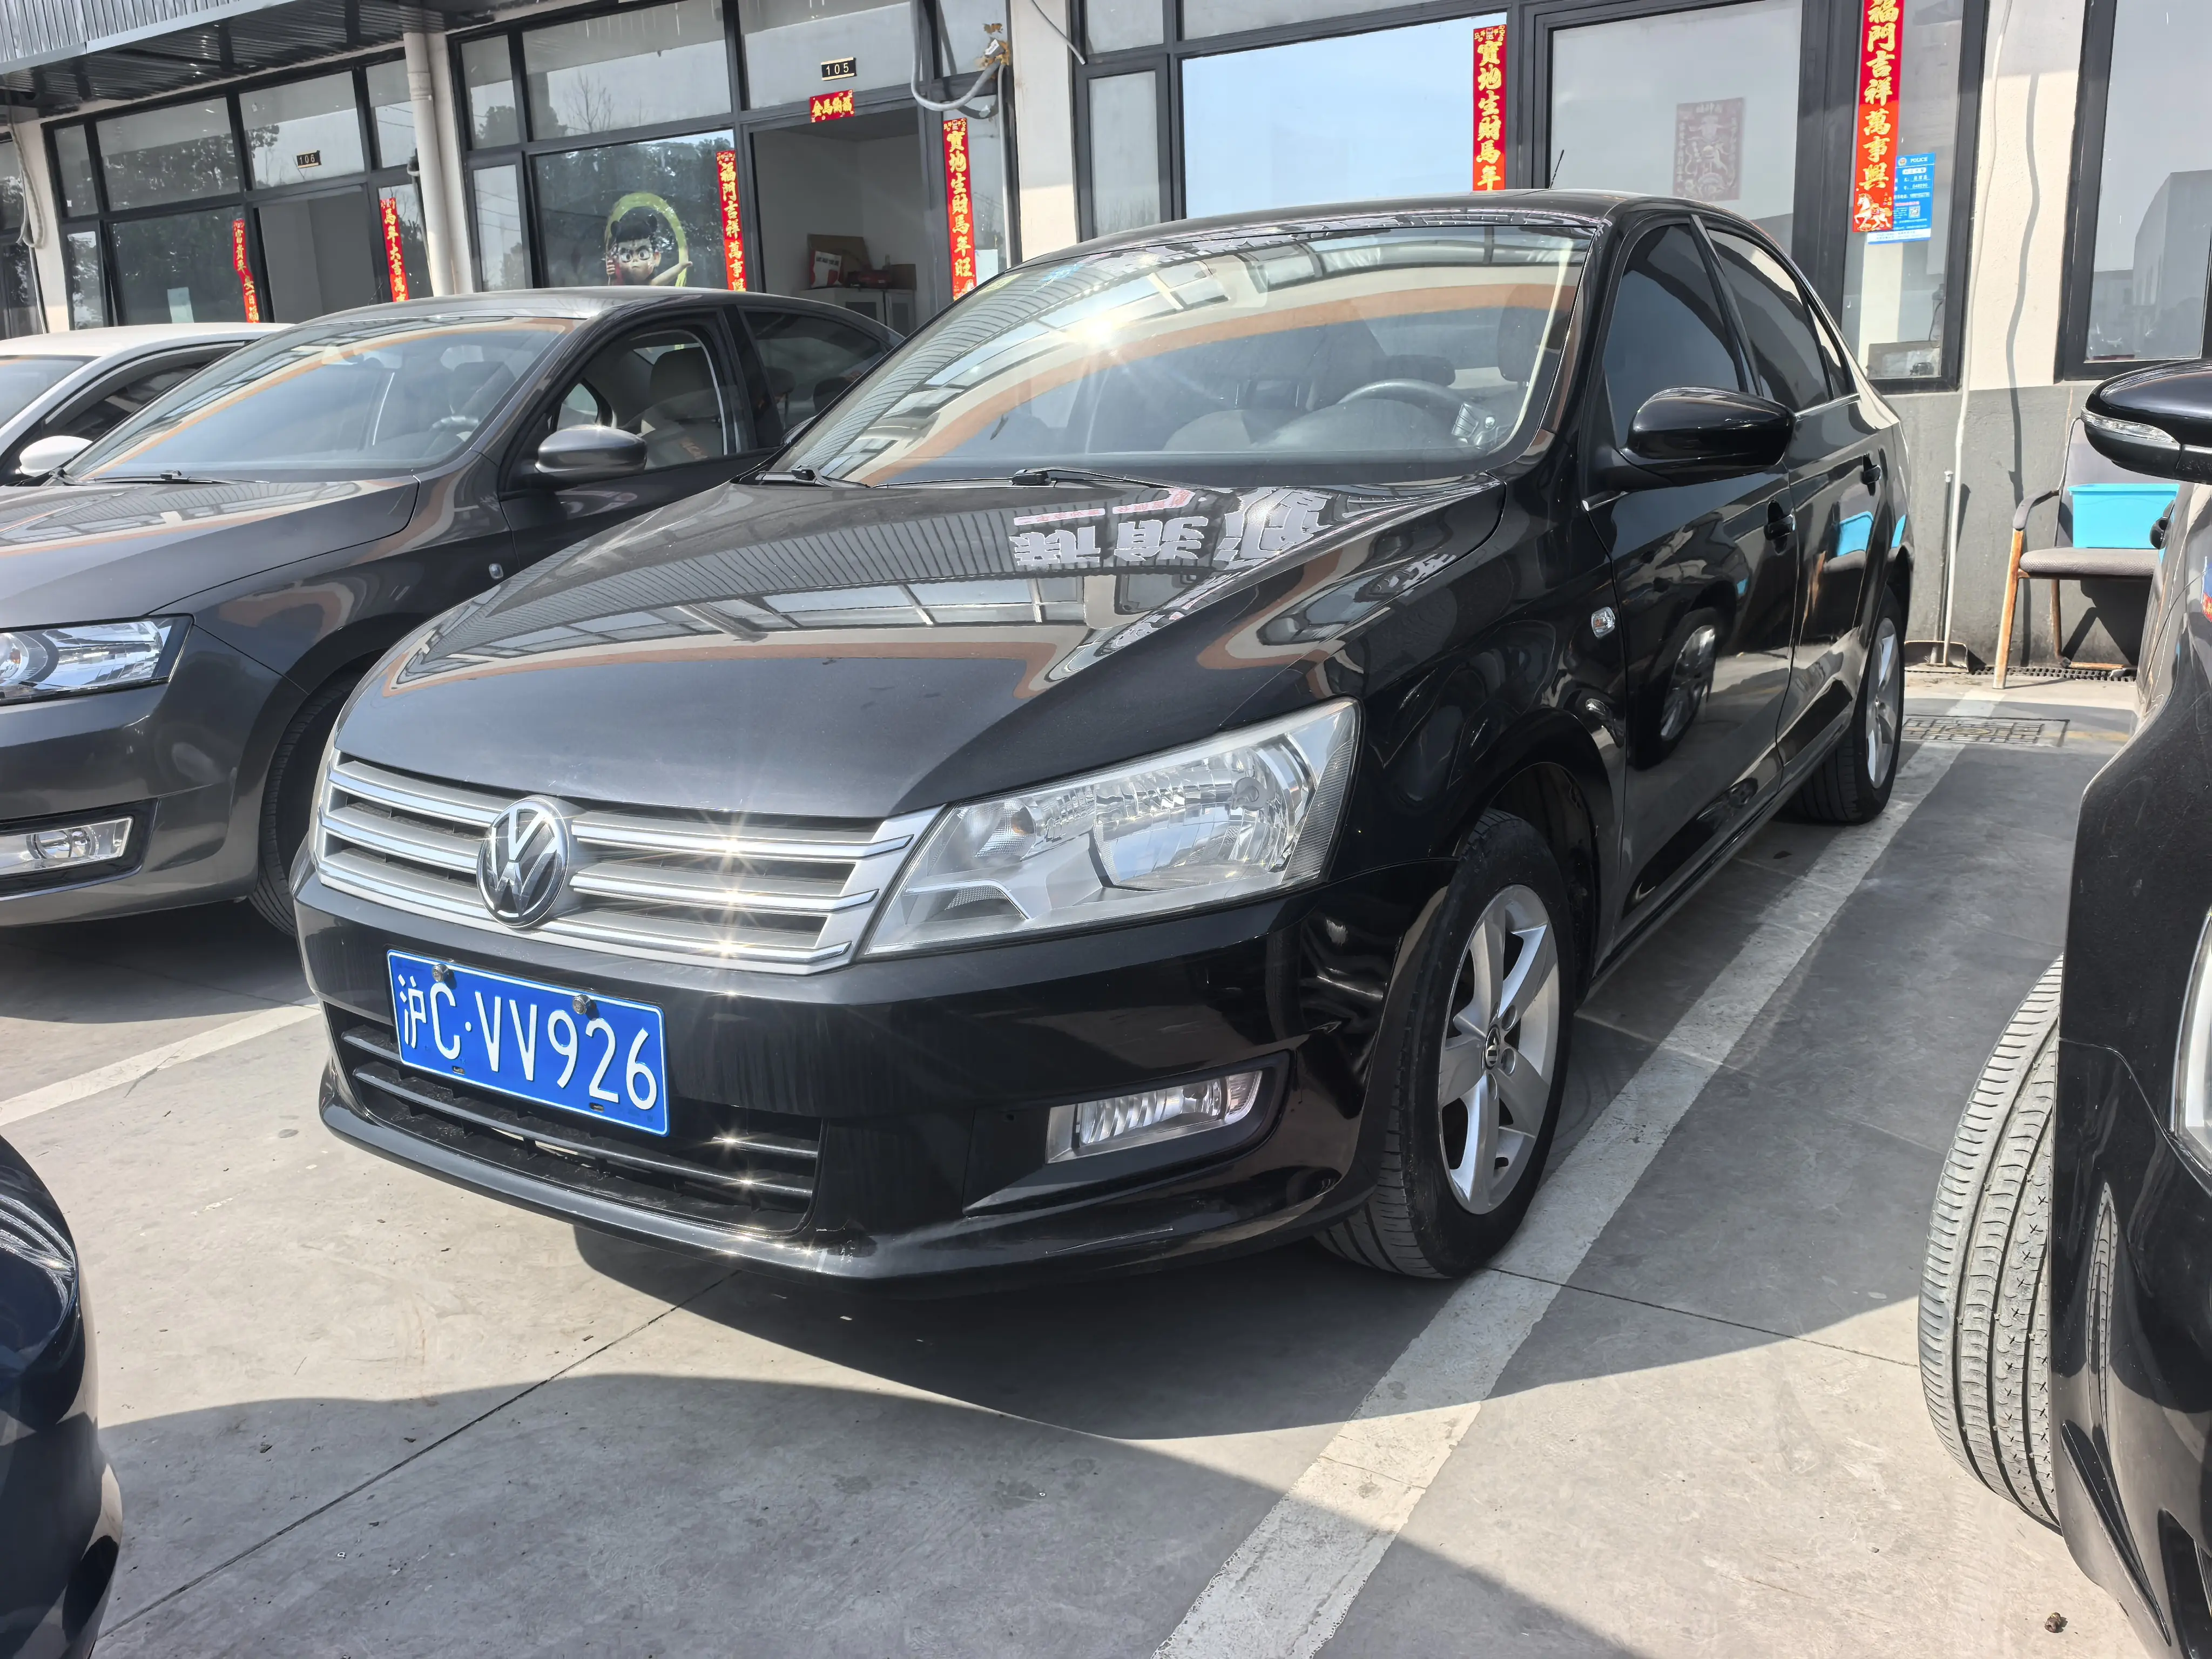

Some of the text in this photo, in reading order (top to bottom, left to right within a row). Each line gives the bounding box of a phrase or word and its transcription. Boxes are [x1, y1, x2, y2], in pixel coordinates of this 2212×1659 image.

[826, 63, 849, 76] 105
[300, 154, 315, 164] 106
[947, 130, 973, 276] 寶地生財馬年旺
[397, 974, 657, 1110] 沪C·VV926
